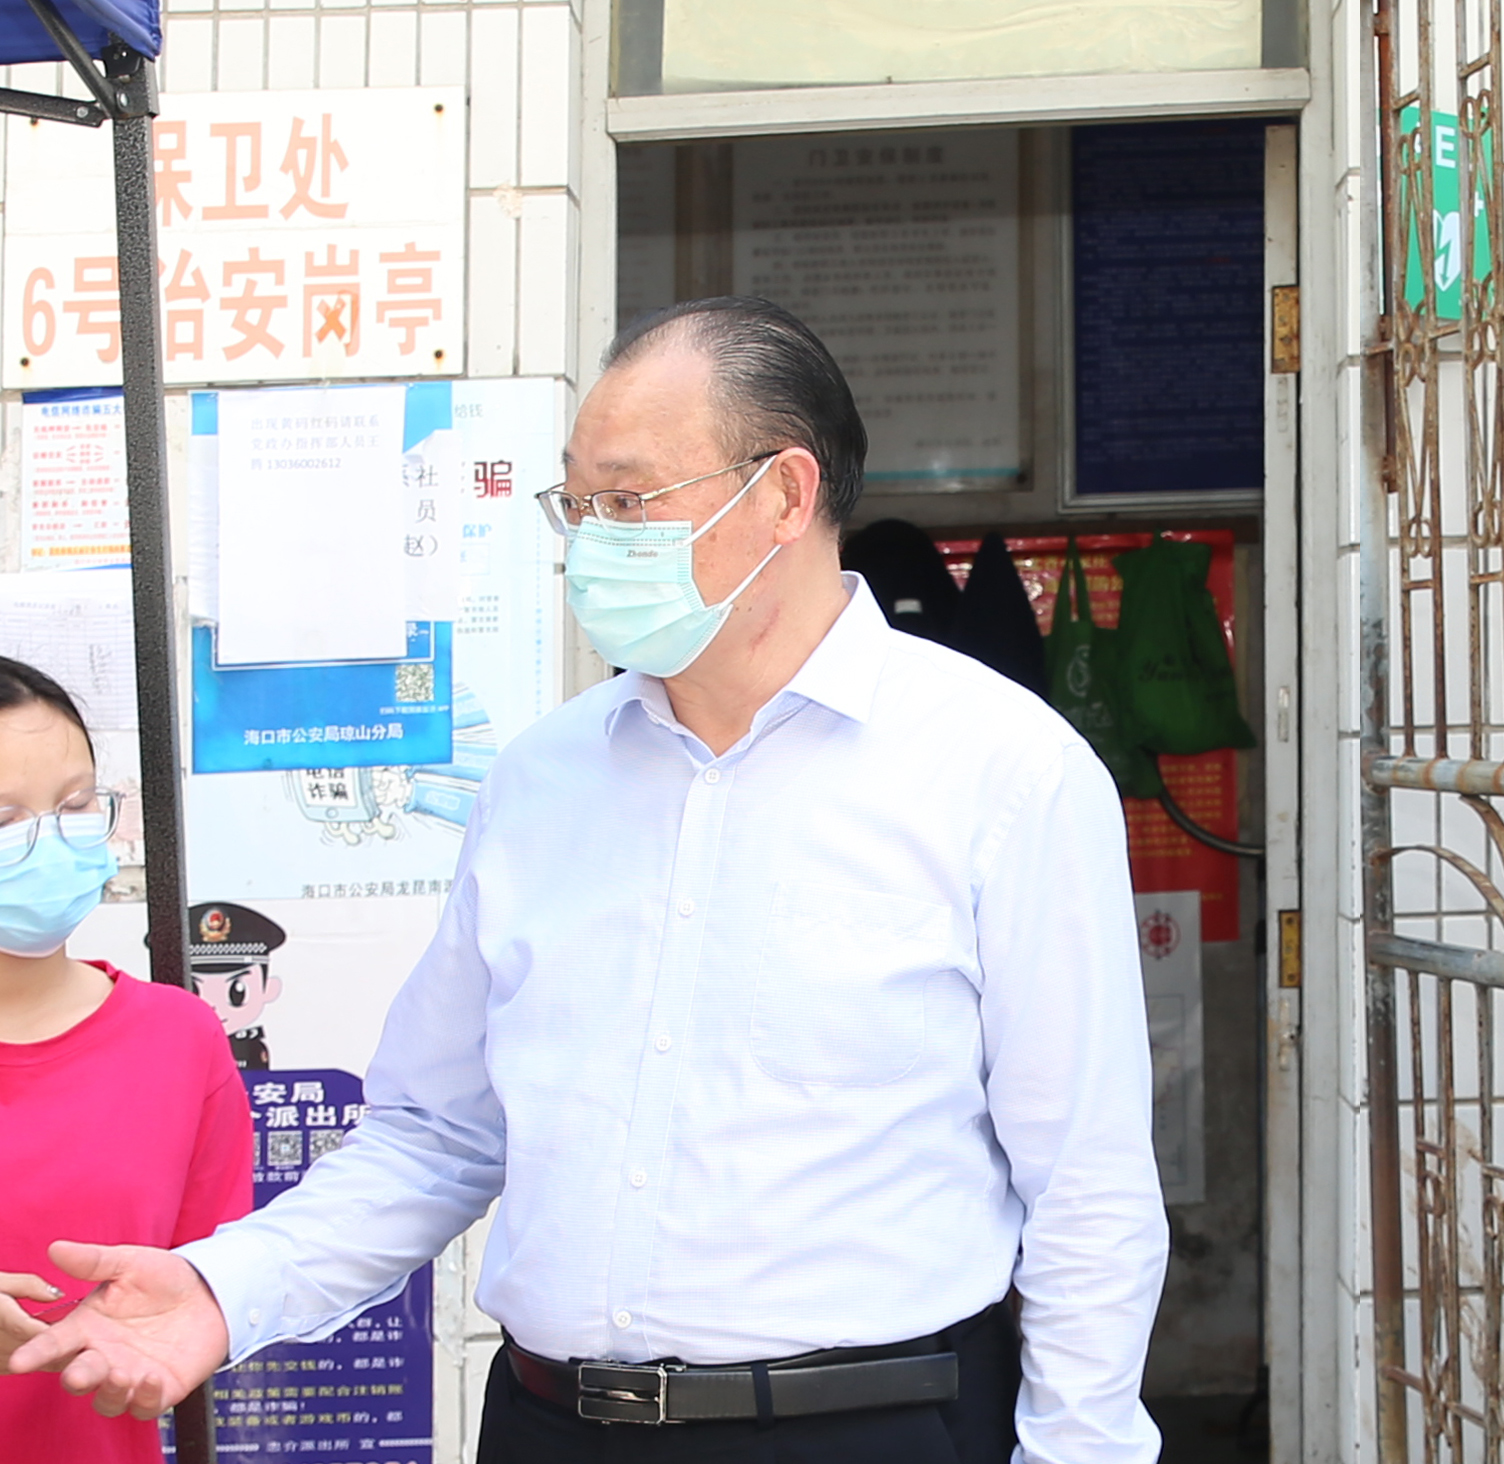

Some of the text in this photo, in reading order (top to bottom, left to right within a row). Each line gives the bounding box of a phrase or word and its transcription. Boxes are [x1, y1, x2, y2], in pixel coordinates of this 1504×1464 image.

[473, 458, 513, 499] 骗
[416, 499, 437, 524] 员
[244, 723, 404, 746] 海口市公安局琼山分局
[248, 1081, 324, 1105] 安局
[250, 1104, 372, 1128] 派出所
